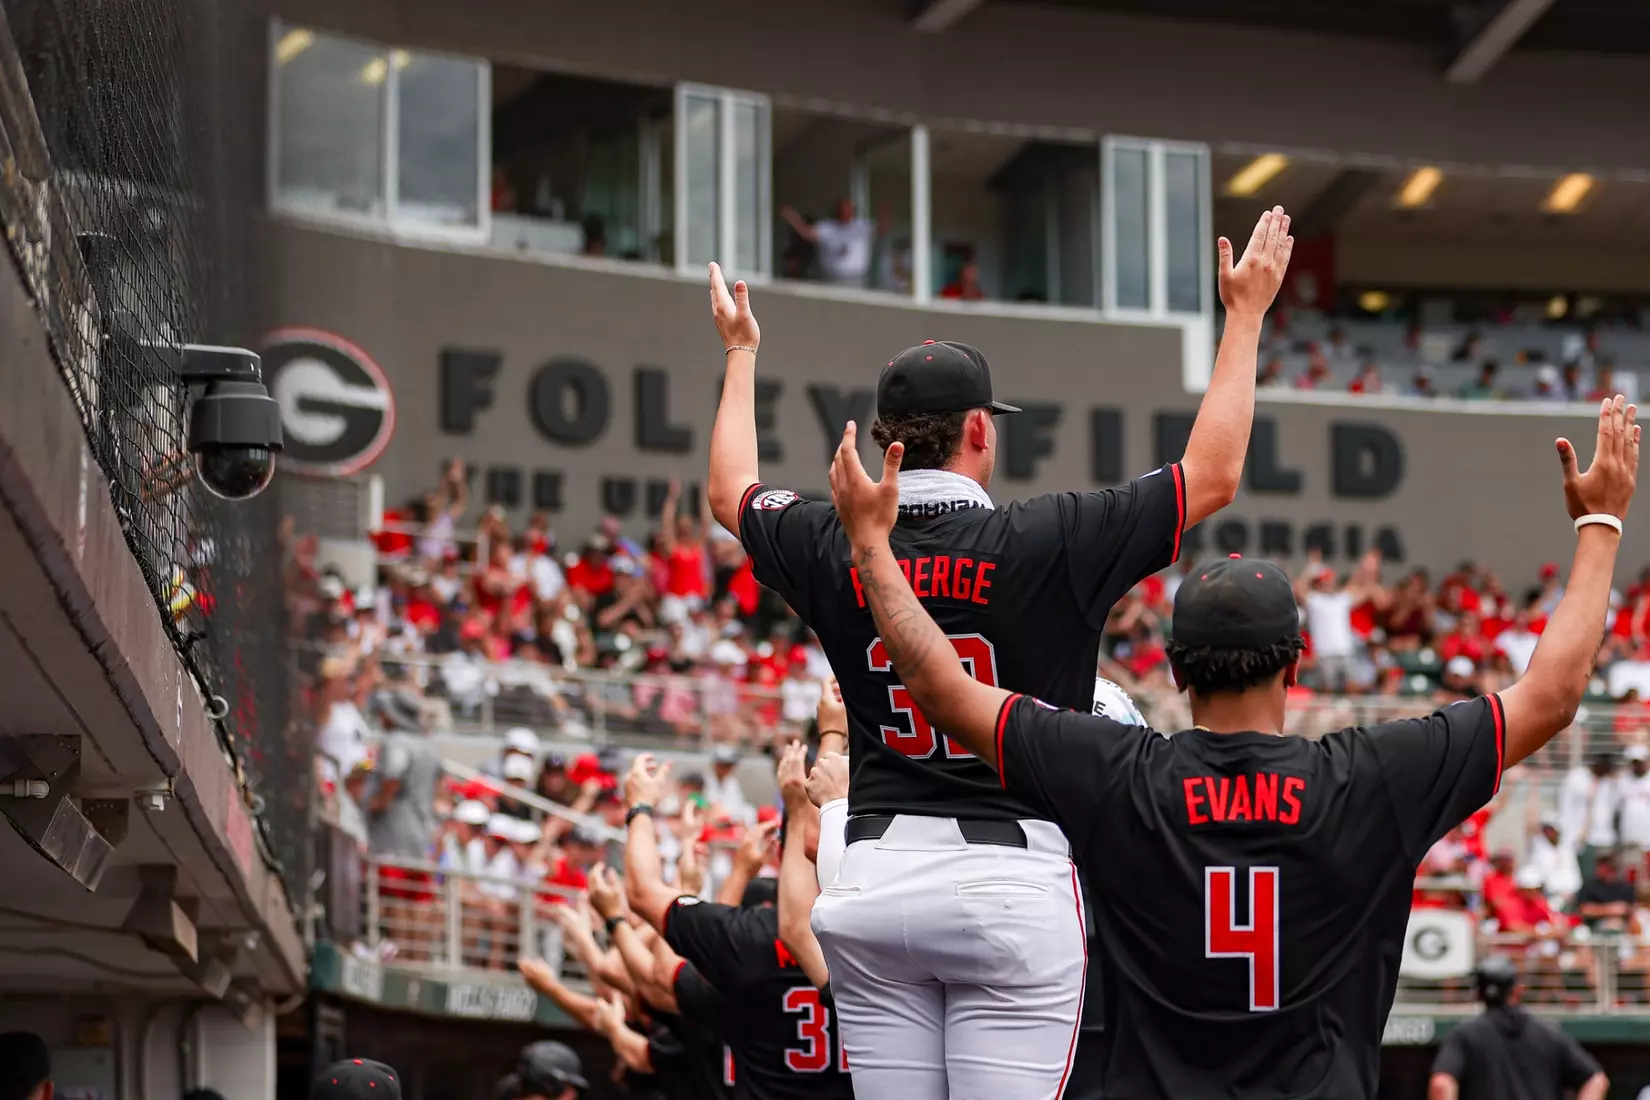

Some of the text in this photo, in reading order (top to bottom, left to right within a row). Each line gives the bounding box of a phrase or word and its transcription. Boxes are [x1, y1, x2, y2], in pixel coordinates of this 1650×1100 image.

[849, 555, 996, 609] ERGE
[1183, 772, 1306, 825] EVANS
[1205, 866, 1280, 1012] 4
[782, 986, 850, 1074] 3
